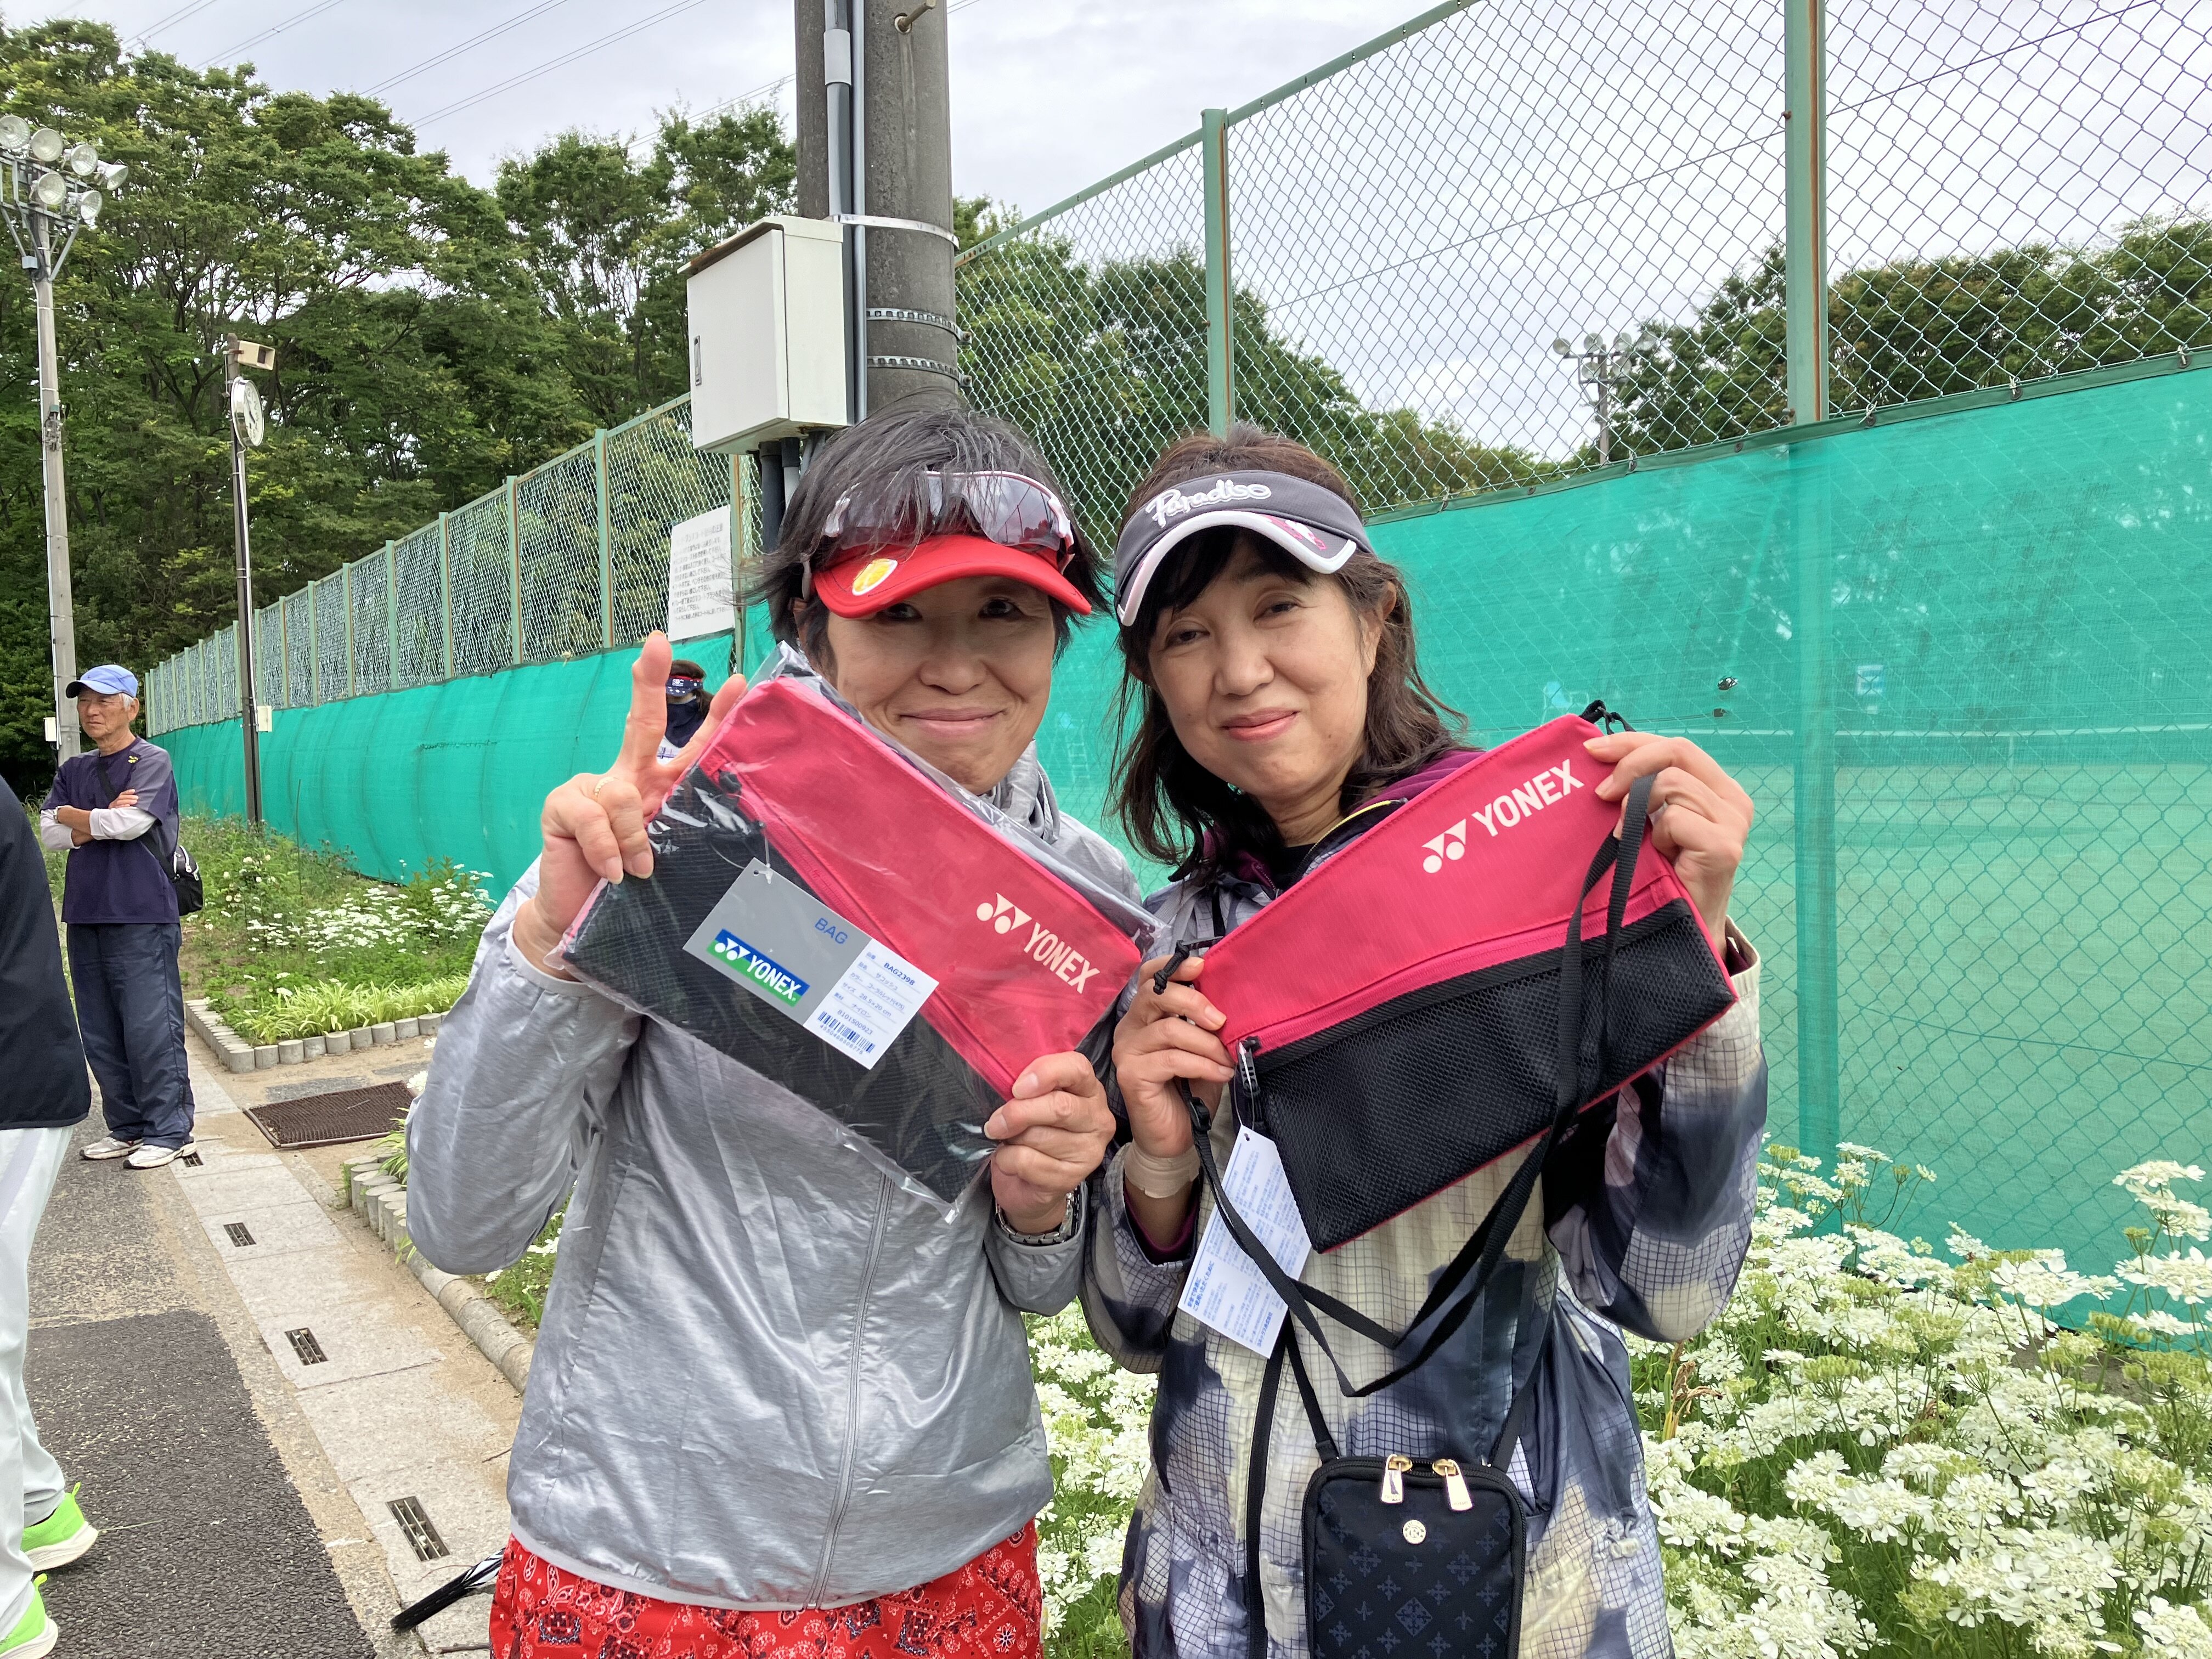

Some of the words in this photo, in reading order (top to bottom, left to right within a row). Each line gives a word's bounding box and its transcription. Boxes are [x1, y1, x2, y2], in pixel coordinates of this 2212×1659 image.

[1146, 479, 1272, 528] Paradiso
[1471, 758, 1585, 837] YONEX
[815, 917, 848, 945] BAG
[747, 954, 802, 1000] YONEX
[884, 963, 915, 985] BAG2398
[1024, 922, 1101, 995] YONEX
